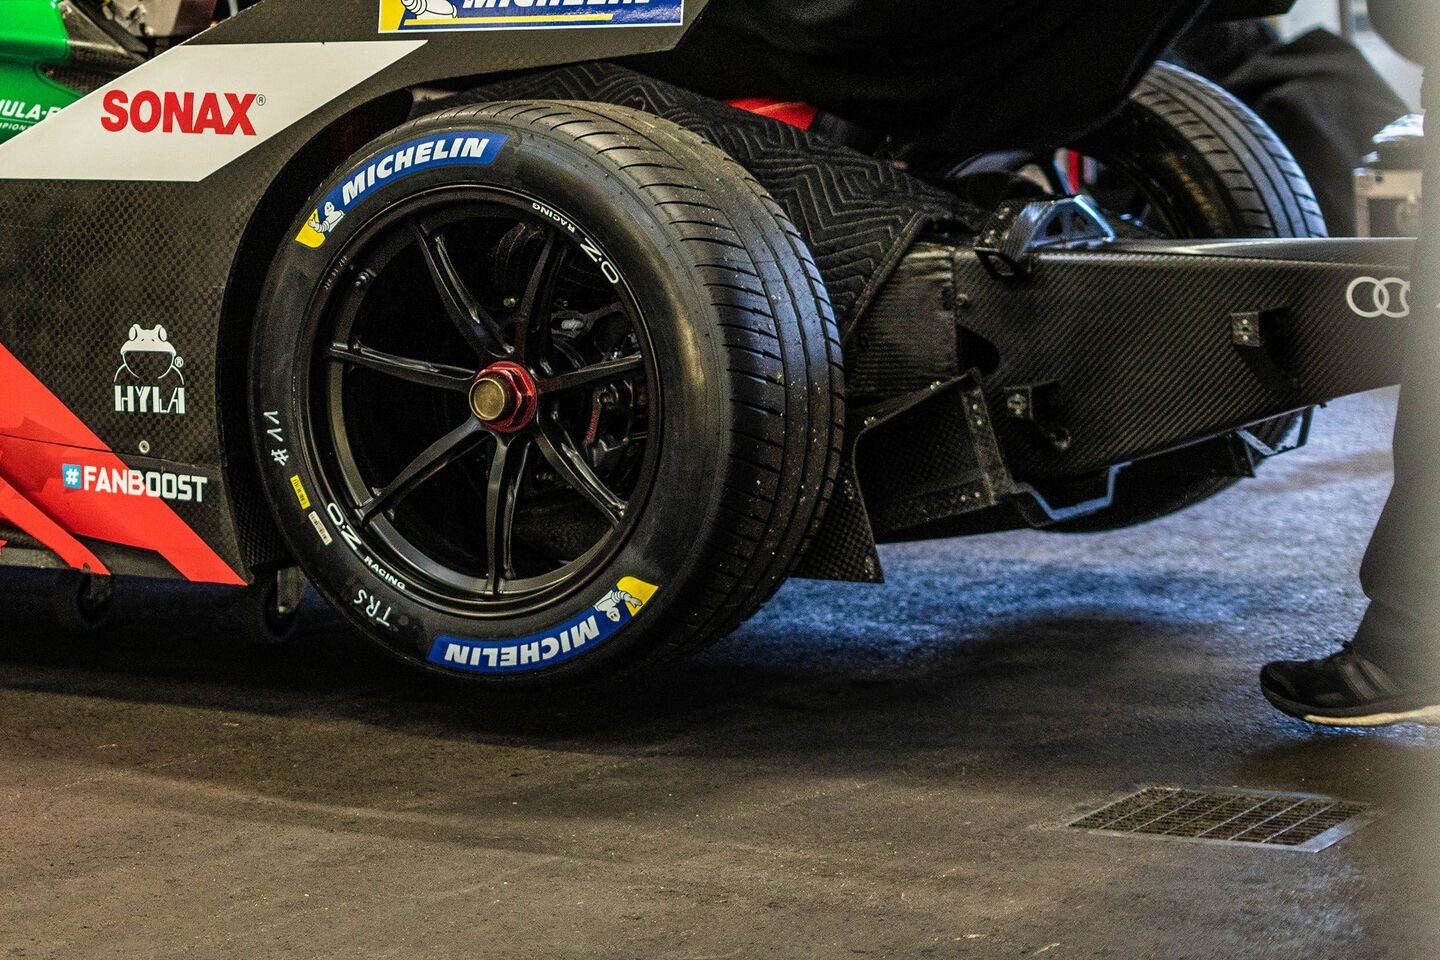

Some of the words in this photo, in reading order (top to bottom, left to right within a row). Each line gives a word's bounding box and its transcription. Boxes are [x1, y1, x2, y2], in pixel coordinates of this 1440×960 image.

[101, 89, 257, 136] SONAX
[342, 137, 490, 206] MICHELIN
[531, 202, 576, 233] RACING
[114, 385, 186, 414] HYLA
[363, 555, 406, 590] RACING
[353, 589, 391, 627] TRS
[444, 615, 600, 667] MICHELIN
